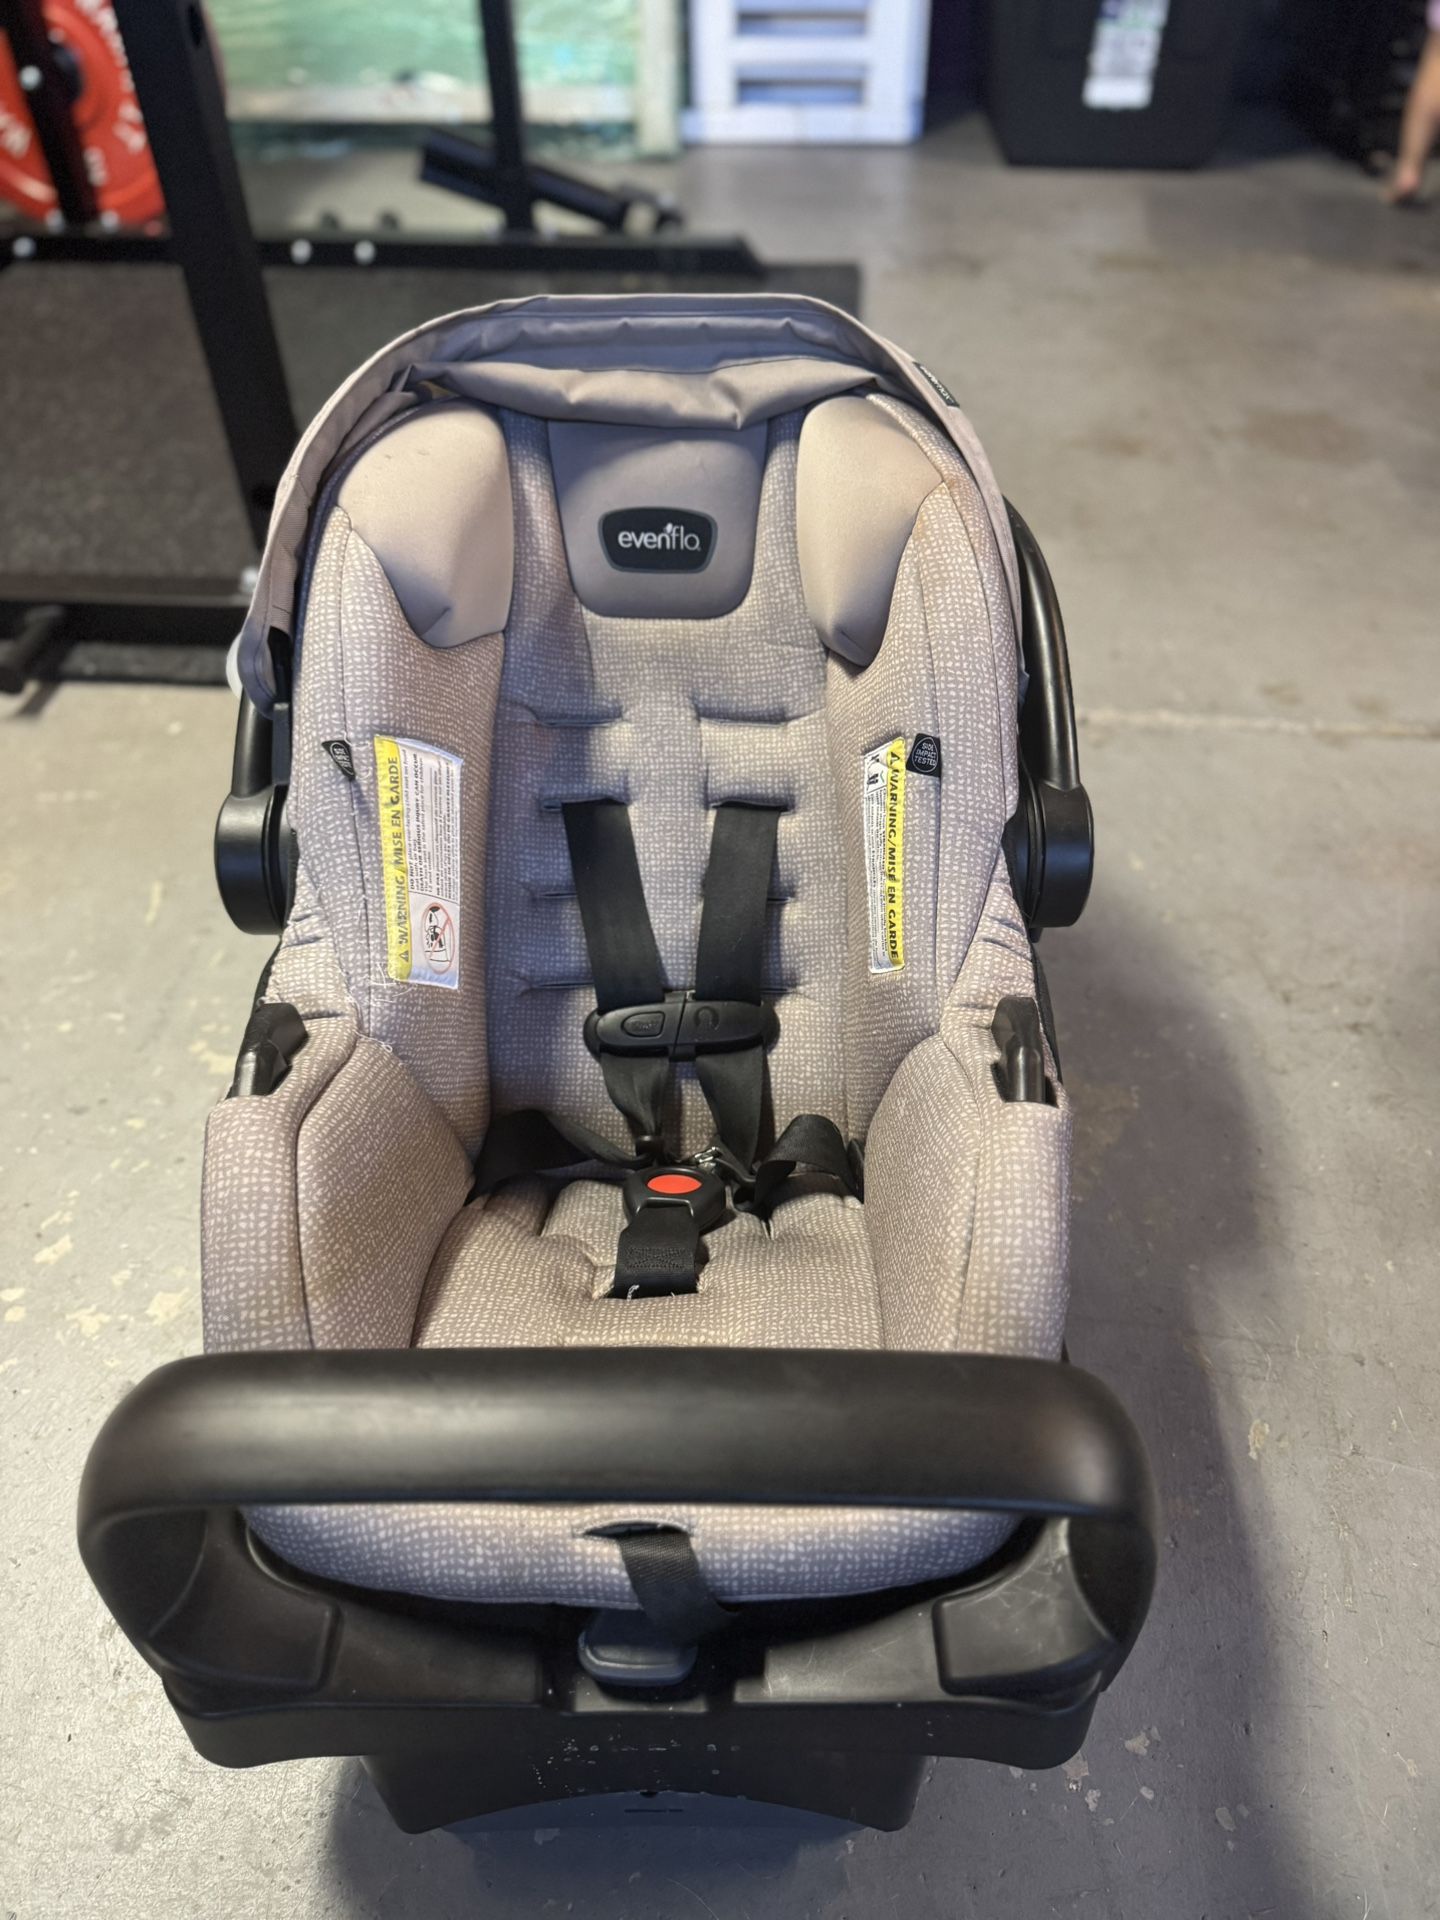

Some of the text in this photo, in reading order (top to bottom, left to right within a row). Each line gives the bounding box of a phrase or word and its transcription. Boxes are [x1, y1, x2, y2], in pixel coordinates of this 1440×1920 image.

[618, 523, 700, 551] evenflo
[914, 755, 937, 766] TESTED
[915, 749, 937, 759] IMPACT
[389, 756, 400, 806] GARDE
[391, 809, 402, 828] EN
[393, 832, 404, 865] MISE
[888, 886, 897, 904] EN
[397, 875, 409, 945] WARNING
[889, 909, 899, 959] GARDE
